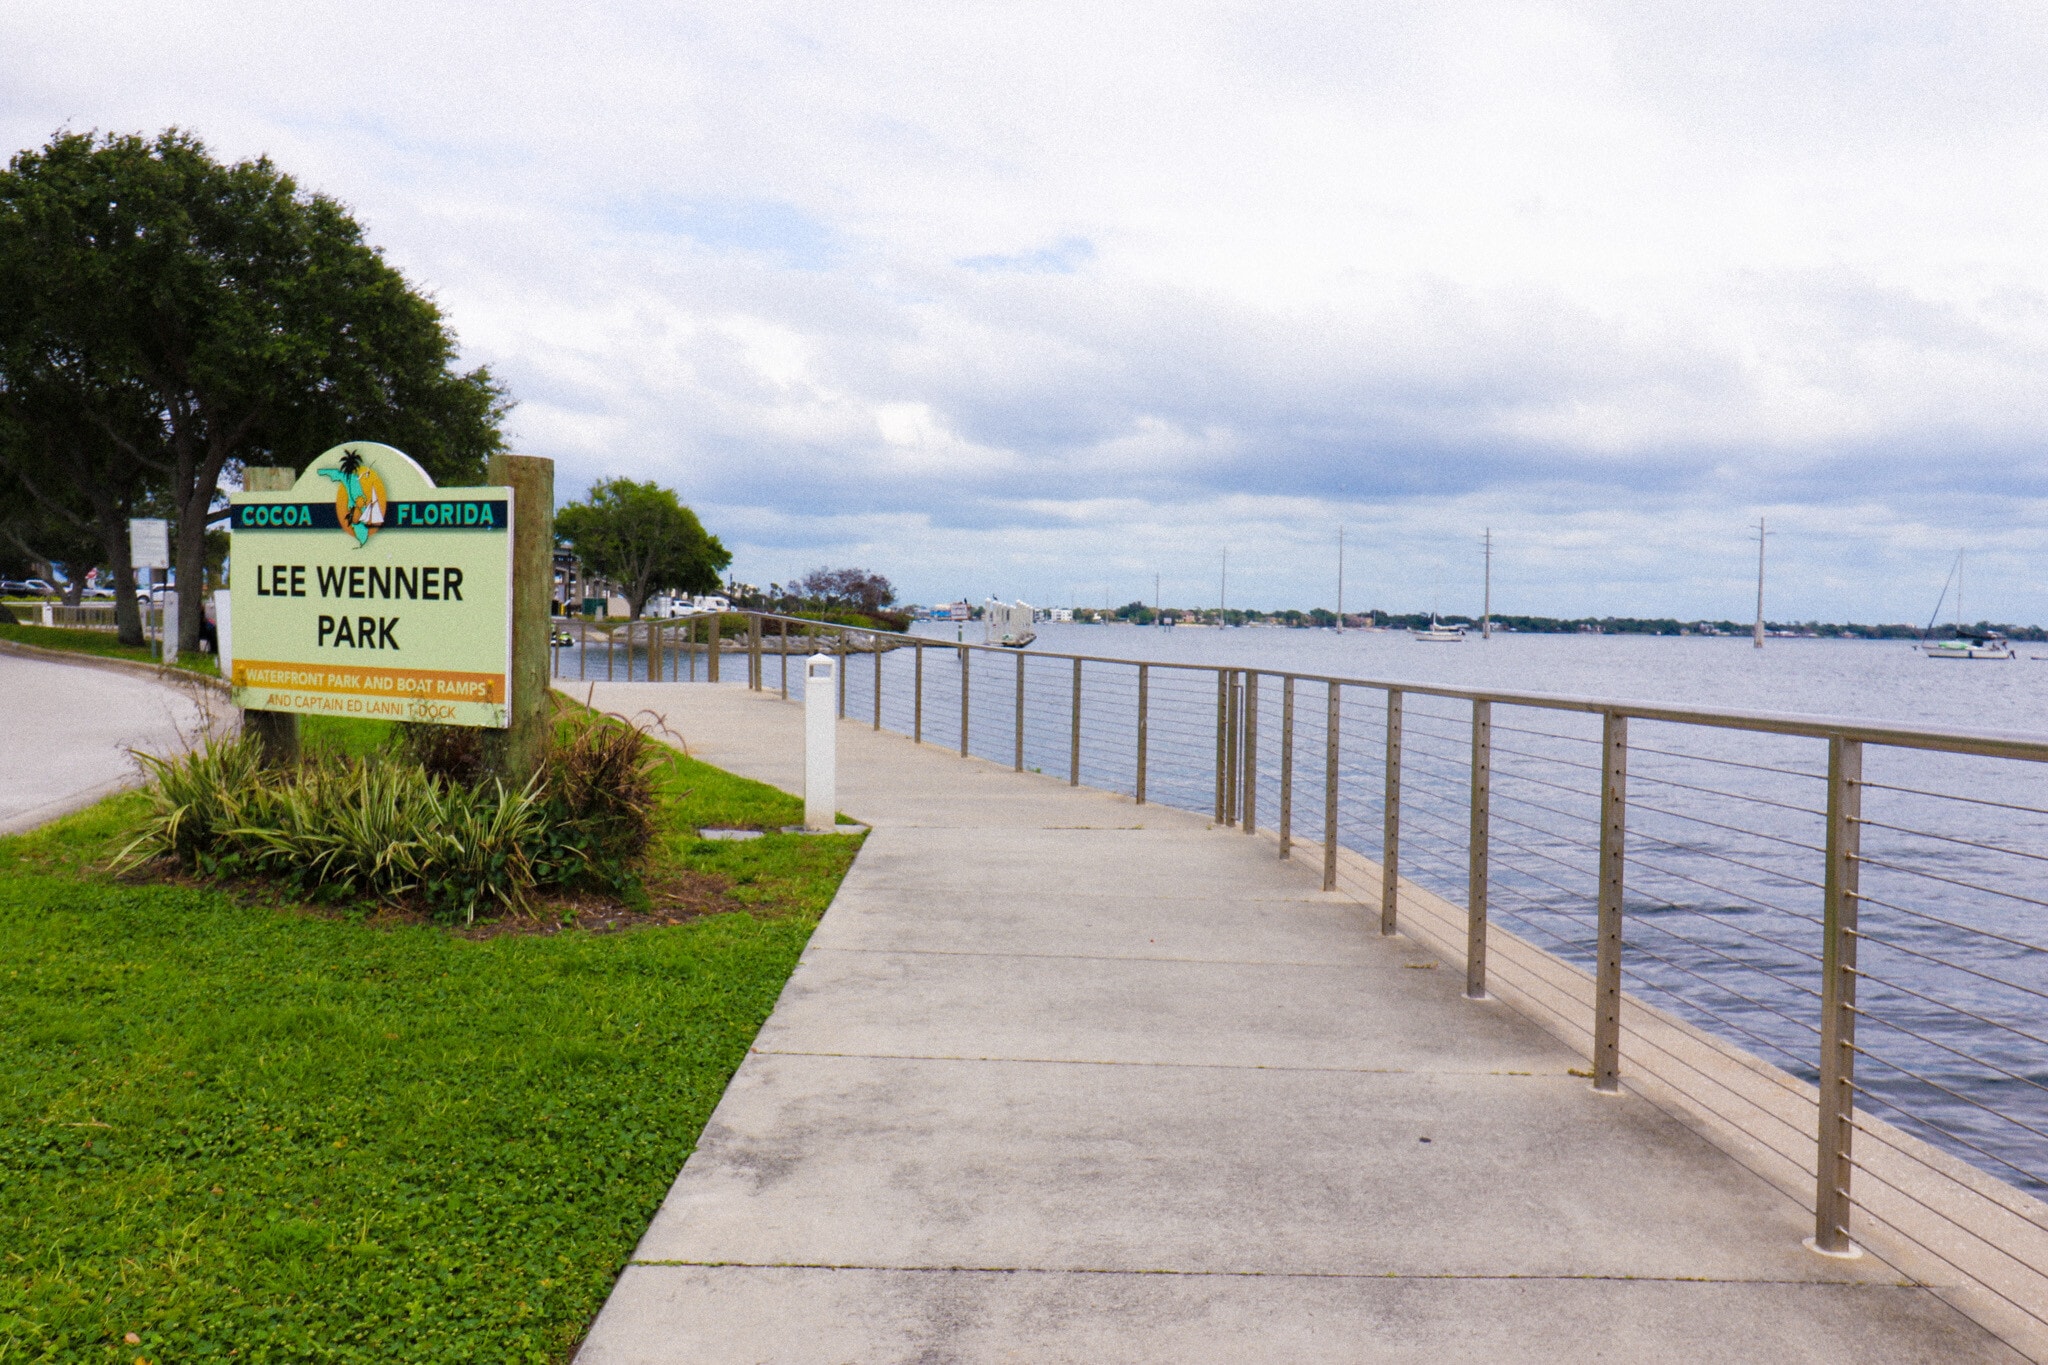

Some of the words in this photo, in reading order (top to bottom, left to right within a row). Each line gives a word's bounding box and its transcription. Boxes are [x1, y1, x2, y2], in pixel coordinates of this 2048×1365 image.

[241, 505, 313, 526] COCOA
[397, 503, 494, 526] FLORIDA
[257, 565, 306, 597] LEE
[317, 565, 463, 601] WENNER
[317, 615, 400, 651] PARK
[246, 668, 325, 686] WATERFRONT
[327, 673, 360, 689] PARK
[363, 675, 394, 690] AND
[397, 677, 433, 693] BOAT
[436, 680, 487, 697] RAMPS
[266, 694, 291, 707] AND
[294, 695, 343, 711] CAPTAIN
[347, 698, 363, 712] ED
[366, 700, 403, 715] LANNI
[418, 703, 456, 719] DOCK
